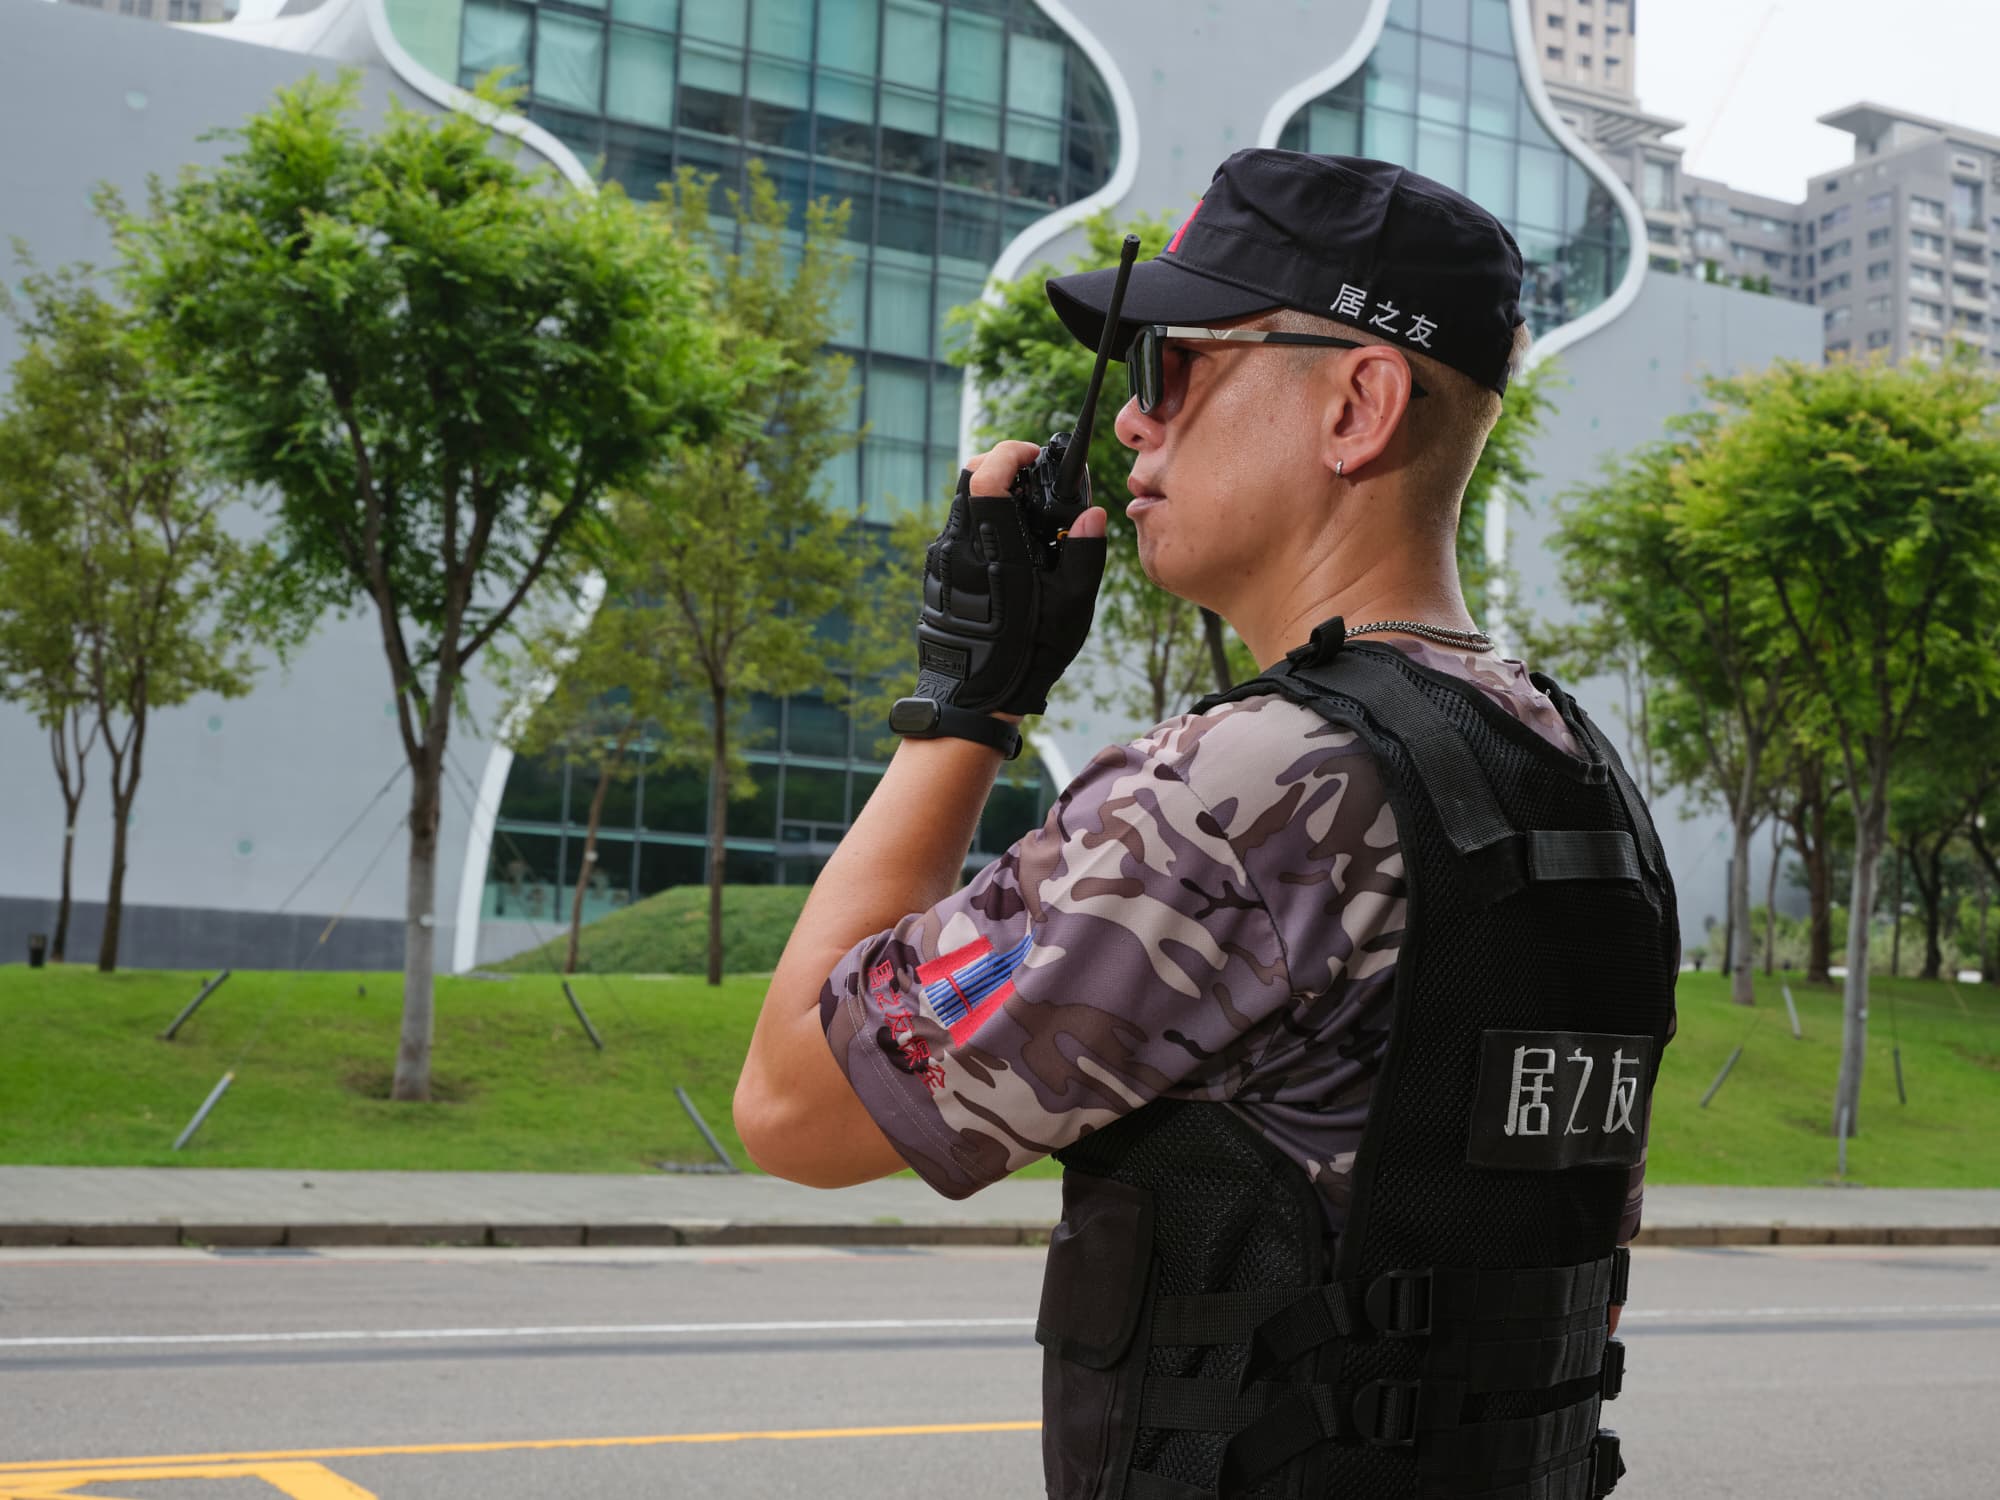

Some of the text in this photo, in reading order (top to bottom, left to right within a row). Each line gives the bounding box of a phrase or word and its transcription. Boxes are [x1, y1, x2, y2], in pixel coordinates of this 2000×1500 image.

[1330, 284, 1438, 348] 居之友
[868, 960, 945, 1095] 居之友保全
[1504, 1046, 1640, 1136] 居之友
